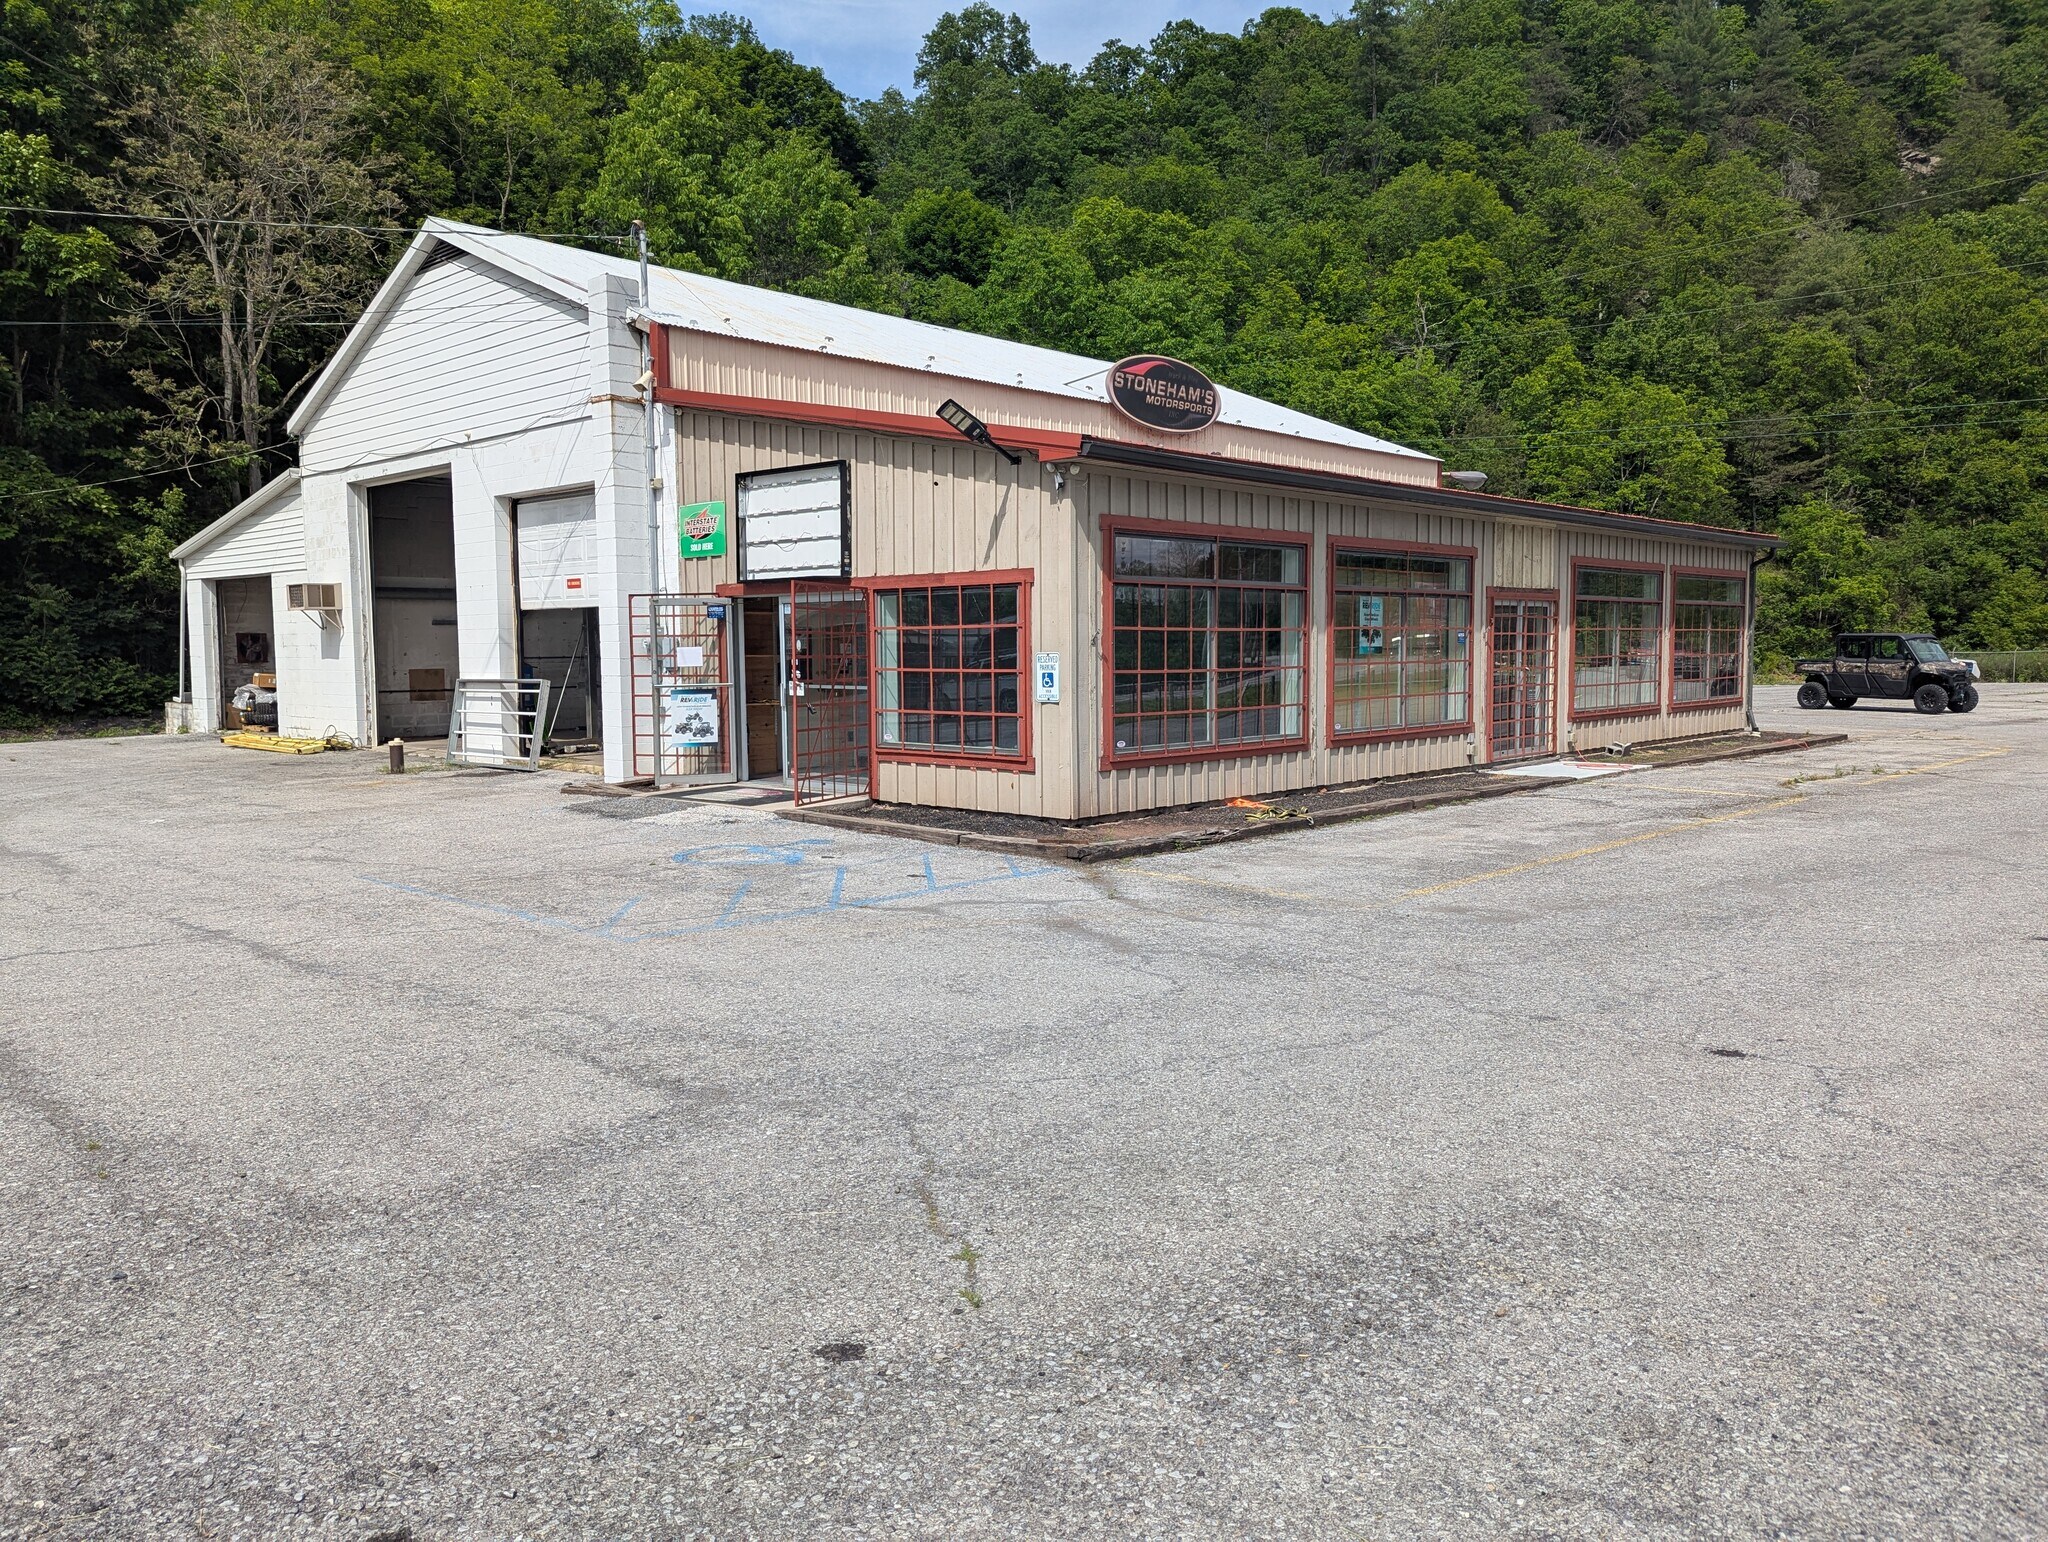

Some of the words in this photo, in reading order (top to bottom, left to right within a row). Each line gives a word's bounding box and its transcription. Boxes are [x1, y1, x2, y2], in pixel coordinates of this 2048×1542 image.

[1114, 372, 1214, 405] STONEHAM'S
[1145, 395, 1213, 416] MOTORSPORTS
[685, 516, 718, 526] INTERSTATE
[685, 525, 716, 535] BATTERIES
[690, 543, 701, 551] SOLD
[702, 542, 713, 550] HERE
[1037, 655, 1058, 663] RESERVED
